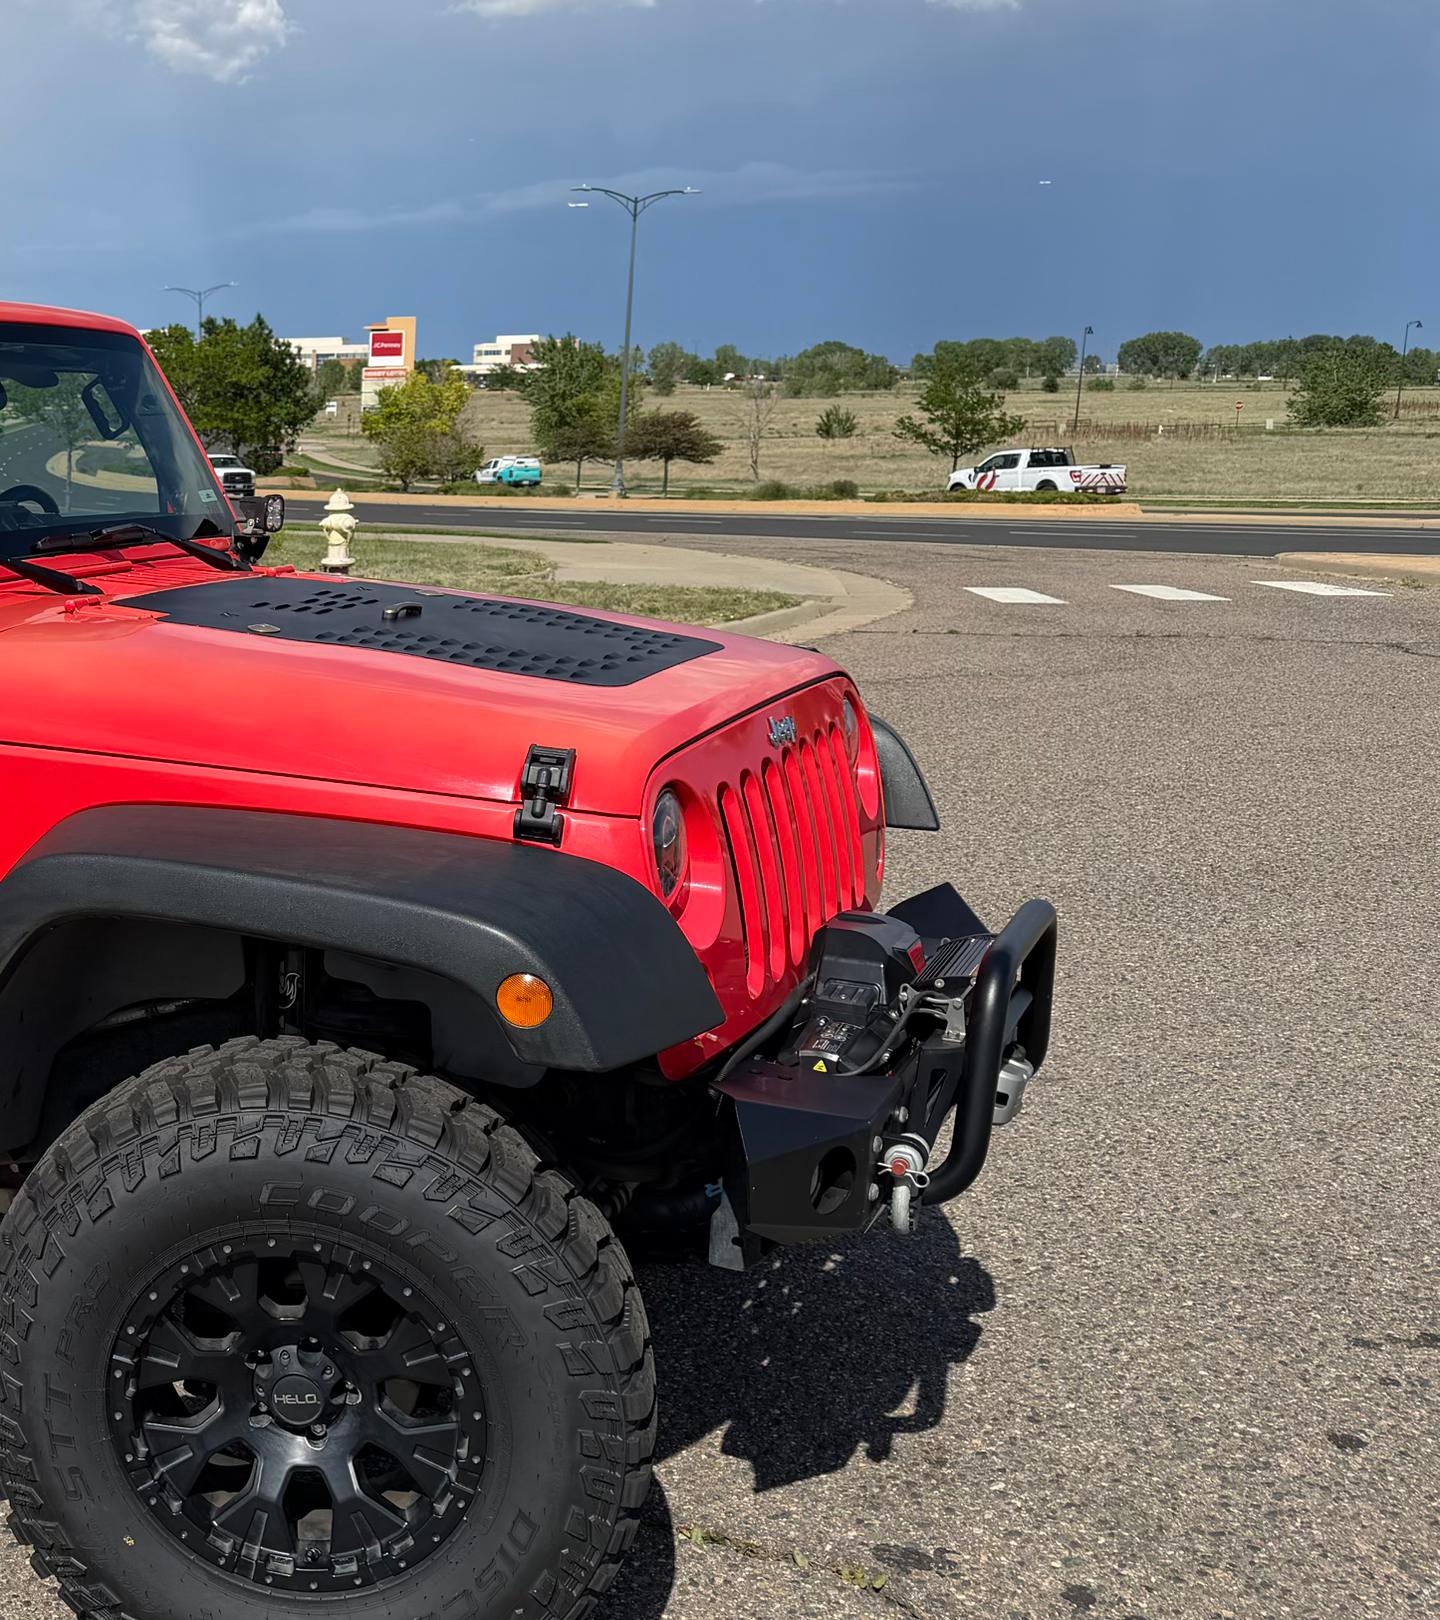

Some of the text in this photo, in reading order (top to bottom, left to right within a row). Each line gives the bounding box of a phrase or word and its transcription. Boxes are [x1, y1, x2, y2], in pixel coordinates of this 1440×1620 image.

[768, 716, 797, 750] Jeep
[259, 1180, 529, 1349] COOPER
[43, 1371, 94, 1504] STT
